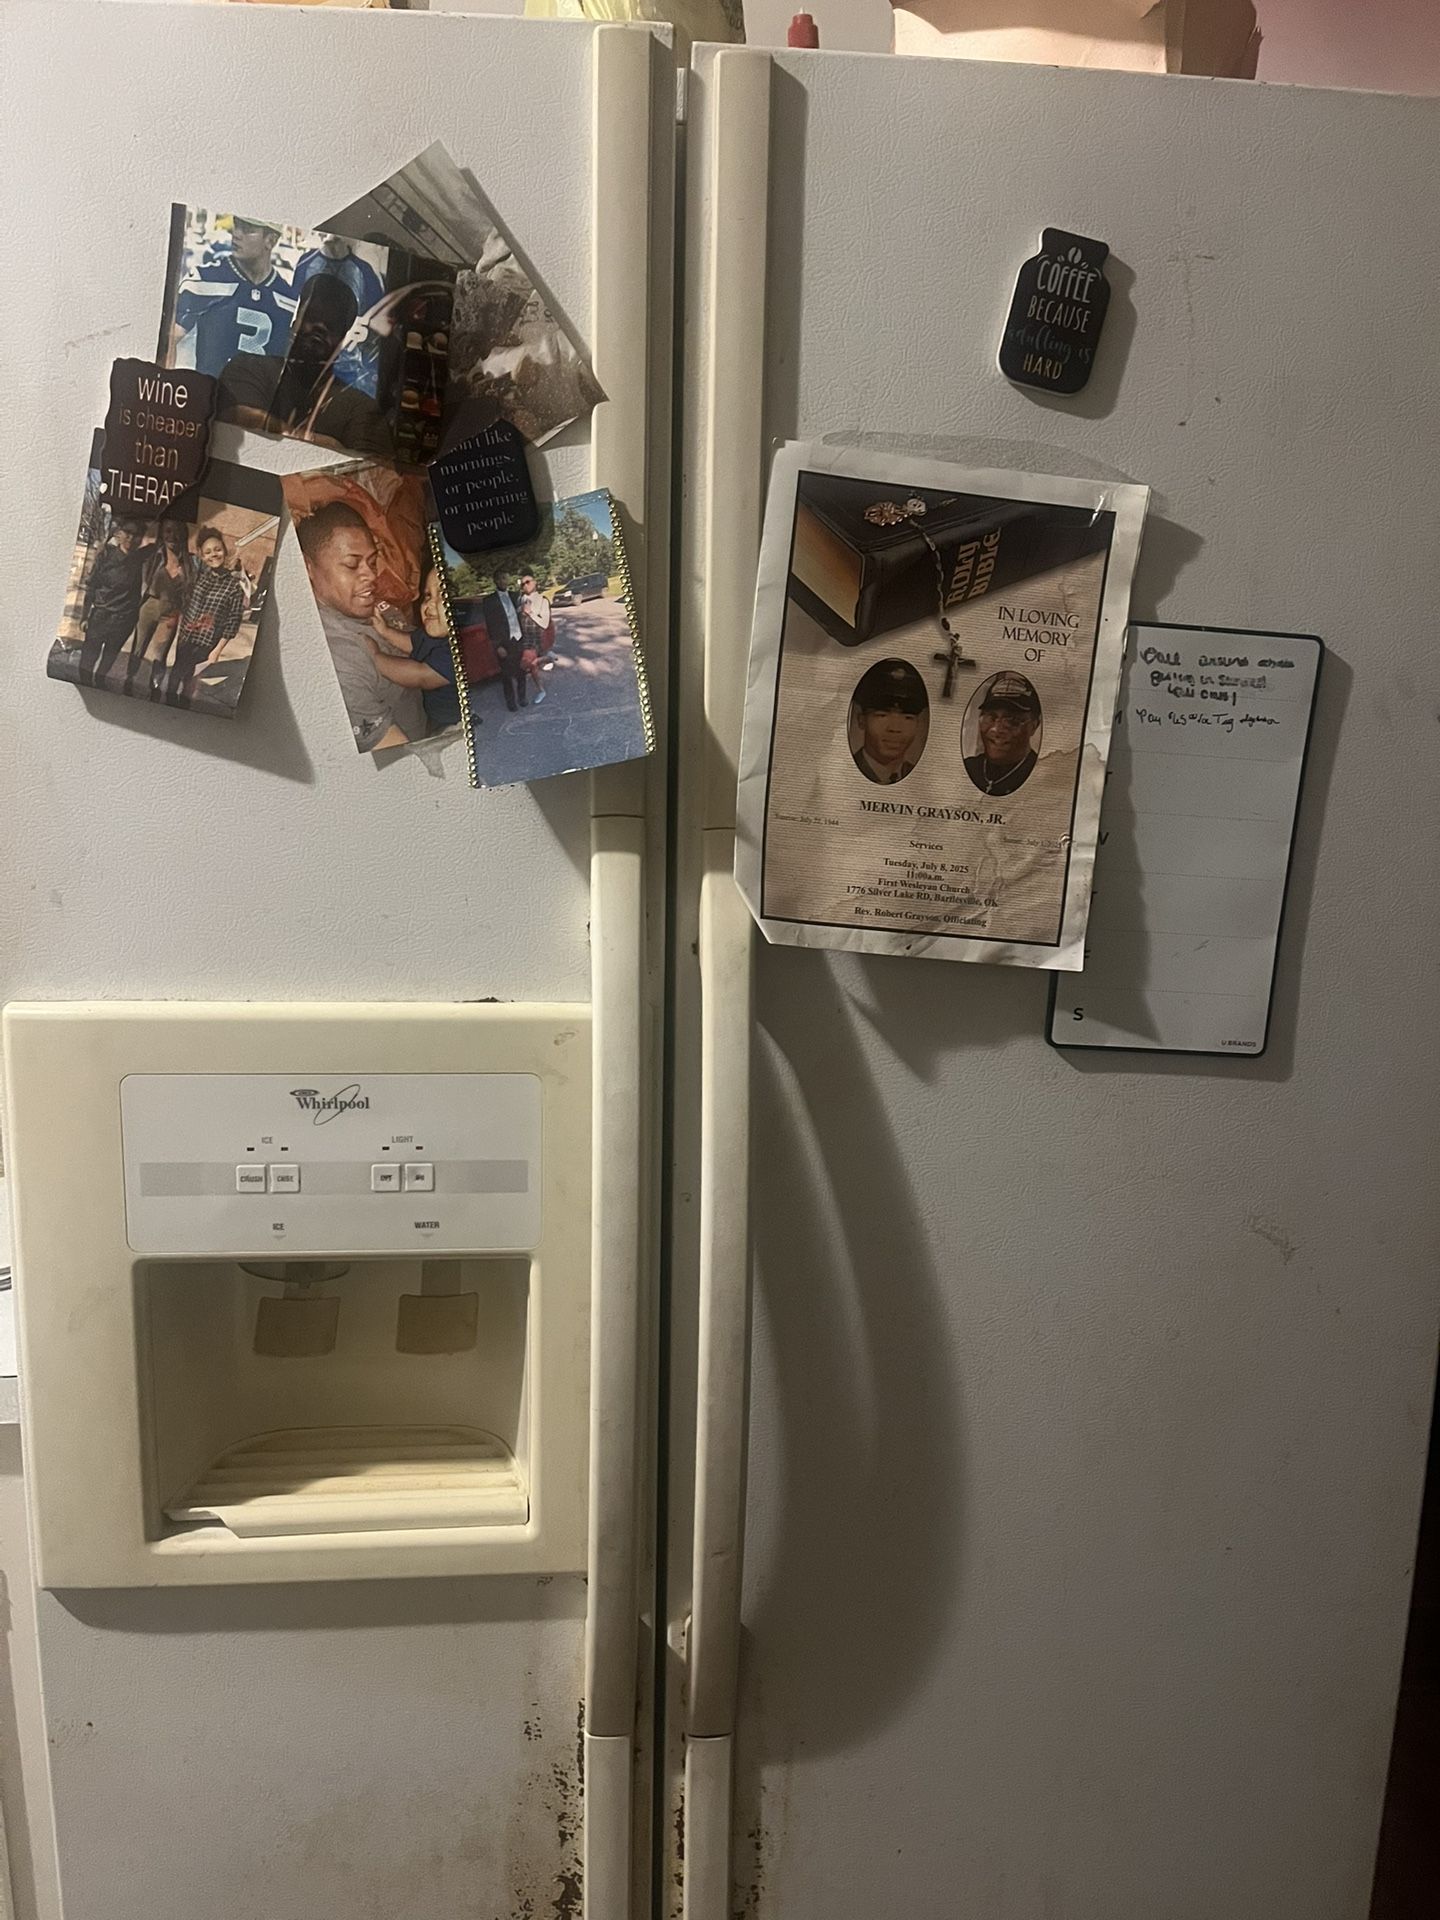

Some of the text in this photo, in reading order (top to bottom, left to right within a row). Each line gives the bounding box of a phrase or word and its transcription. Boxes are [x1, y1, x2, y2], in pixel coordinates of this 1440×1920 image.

[1037, 260, 1097, 303] COFFEE
[1027, 295, 1091, 333] BECAUSE
[1023, 353, 1063, 380] HARD
[138, 373, 188, 409] wine
[119, 402, 201, 440] is cheaper
[484, 429, 512, 446] like
[135, 434, 179, 471] than
[108, 468, 188, 506] THERAP
[445, 484, 462, 495] or
[444, 491, 529, 516] or morning
[467, 511, 516, 535] people
[998, 606, 1080, 630] IN LOVING
[1002, 626, 1071, 647] MEMORY
[1024, 648, 1046, 663] OF
[859, 800, 1006, 825] MERVIN GRAYSON, JR.
[909, 840, 943, 851] Services
[883, 858, 919, 870] Tuesday,
[921, 862, 938, 872] July
[950, 865, 969, 873] 2025
[846, 885, 865, 894] 1776
[867, 888, 892, 896] Silver
[893, 890, 914, 899] Lake
[984, 898, 998, 907] OK
[878, 878, 970, 894] First Wesleyan Church
[854, 906, 872, 916] Rev.
[874, 908, 903, 918] Robert
[943, 915, 987, 927] Officiating
[1073, 1007, 1084, 1020] S
[296, 1097, 370, 1112] Whirlpool
[261, 1136, 273, 1144] ICE
[391, 1136, 413, 1144] LIGHT
[272, 1222, 285, 1231] ICE
[414, 1220, 440, 1230] WATER
